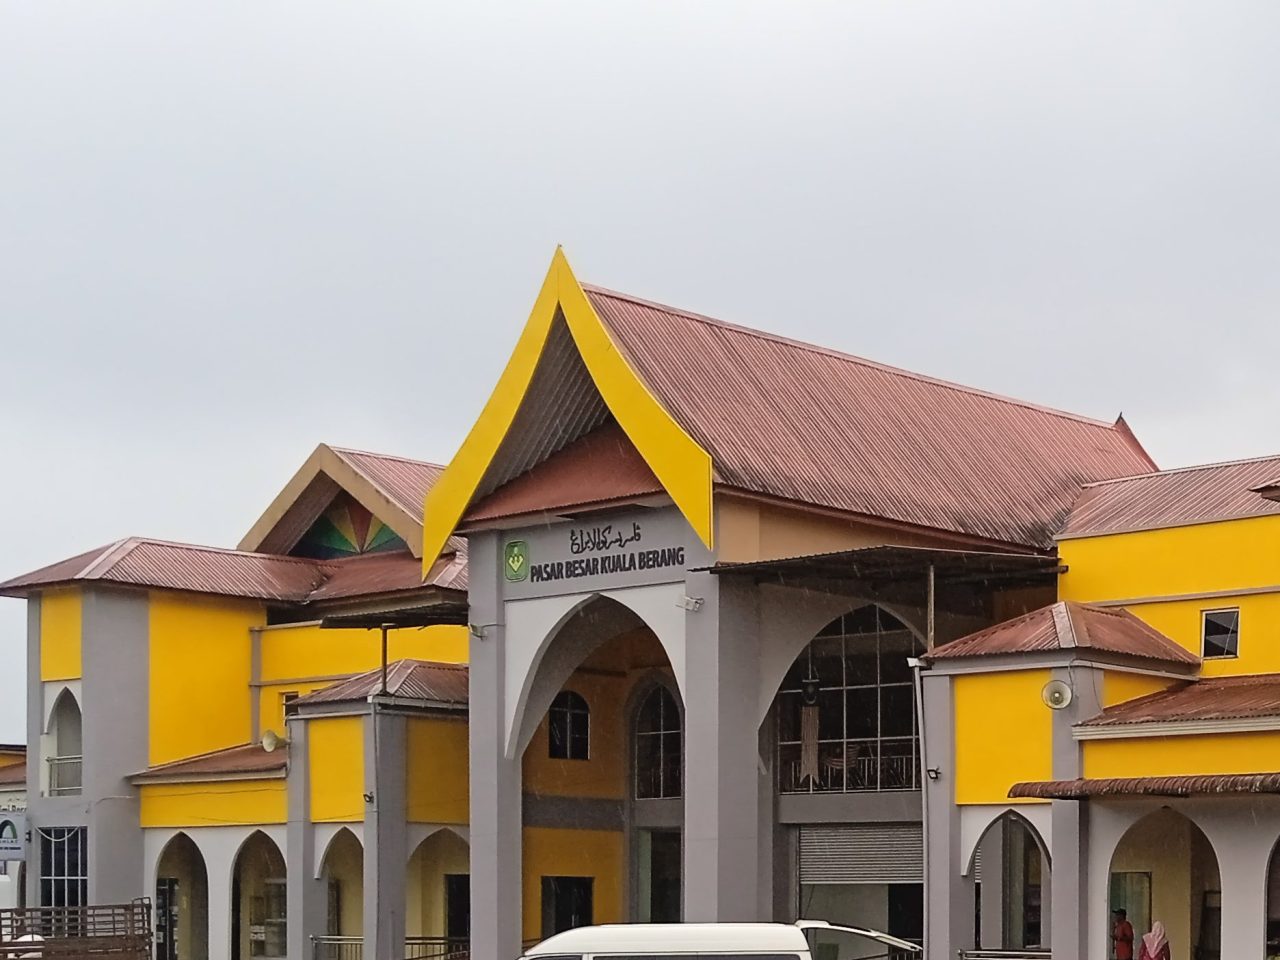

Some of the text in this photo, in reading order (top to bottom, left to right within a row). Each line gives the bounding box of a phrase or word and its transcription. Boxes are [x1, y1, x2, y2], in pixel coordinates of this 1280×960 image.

[530, 547, 685, 582] PASAR BESAR KUALA BERANG
